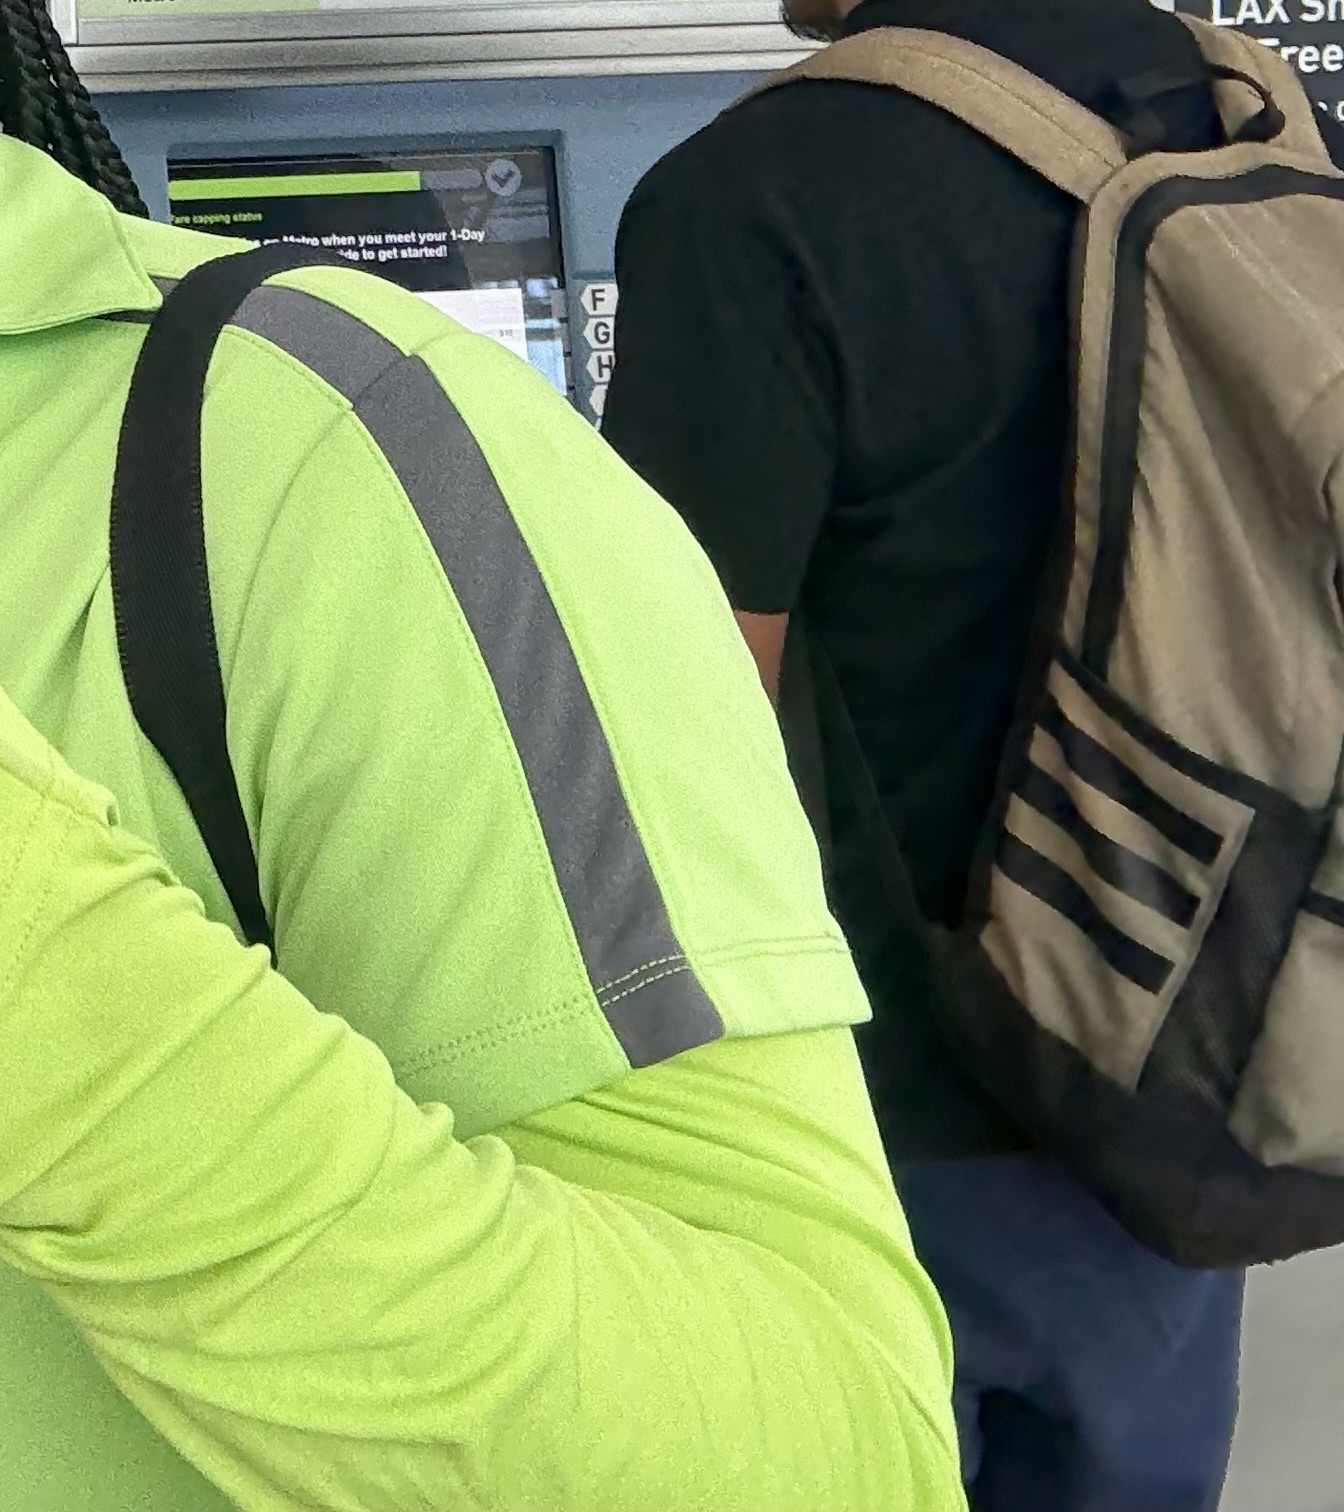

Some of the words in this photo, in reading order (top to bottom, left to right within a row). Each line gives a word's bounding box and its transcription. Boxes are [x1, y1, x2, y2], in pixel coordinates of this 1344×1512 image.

[1257, 37, 1344, 74] ree
[192, 213, 232, 225] capping
[232, 212, 263, 222] status
[321, 232, 356, 247] when
[357, 233, 383, 248] you
[384, 230, 416, 244] meet
[417, 231, 448, 246] your
[449, 227, 486, 243] 1-Day
[362, 248, 376, 261] to
[377, 247, 399, 263] get
[400, 244, 449, 259] started!
[590, 288, 606, 312] F
[593, 321, 611, 345] G
[596, 354, 613, 379] H
